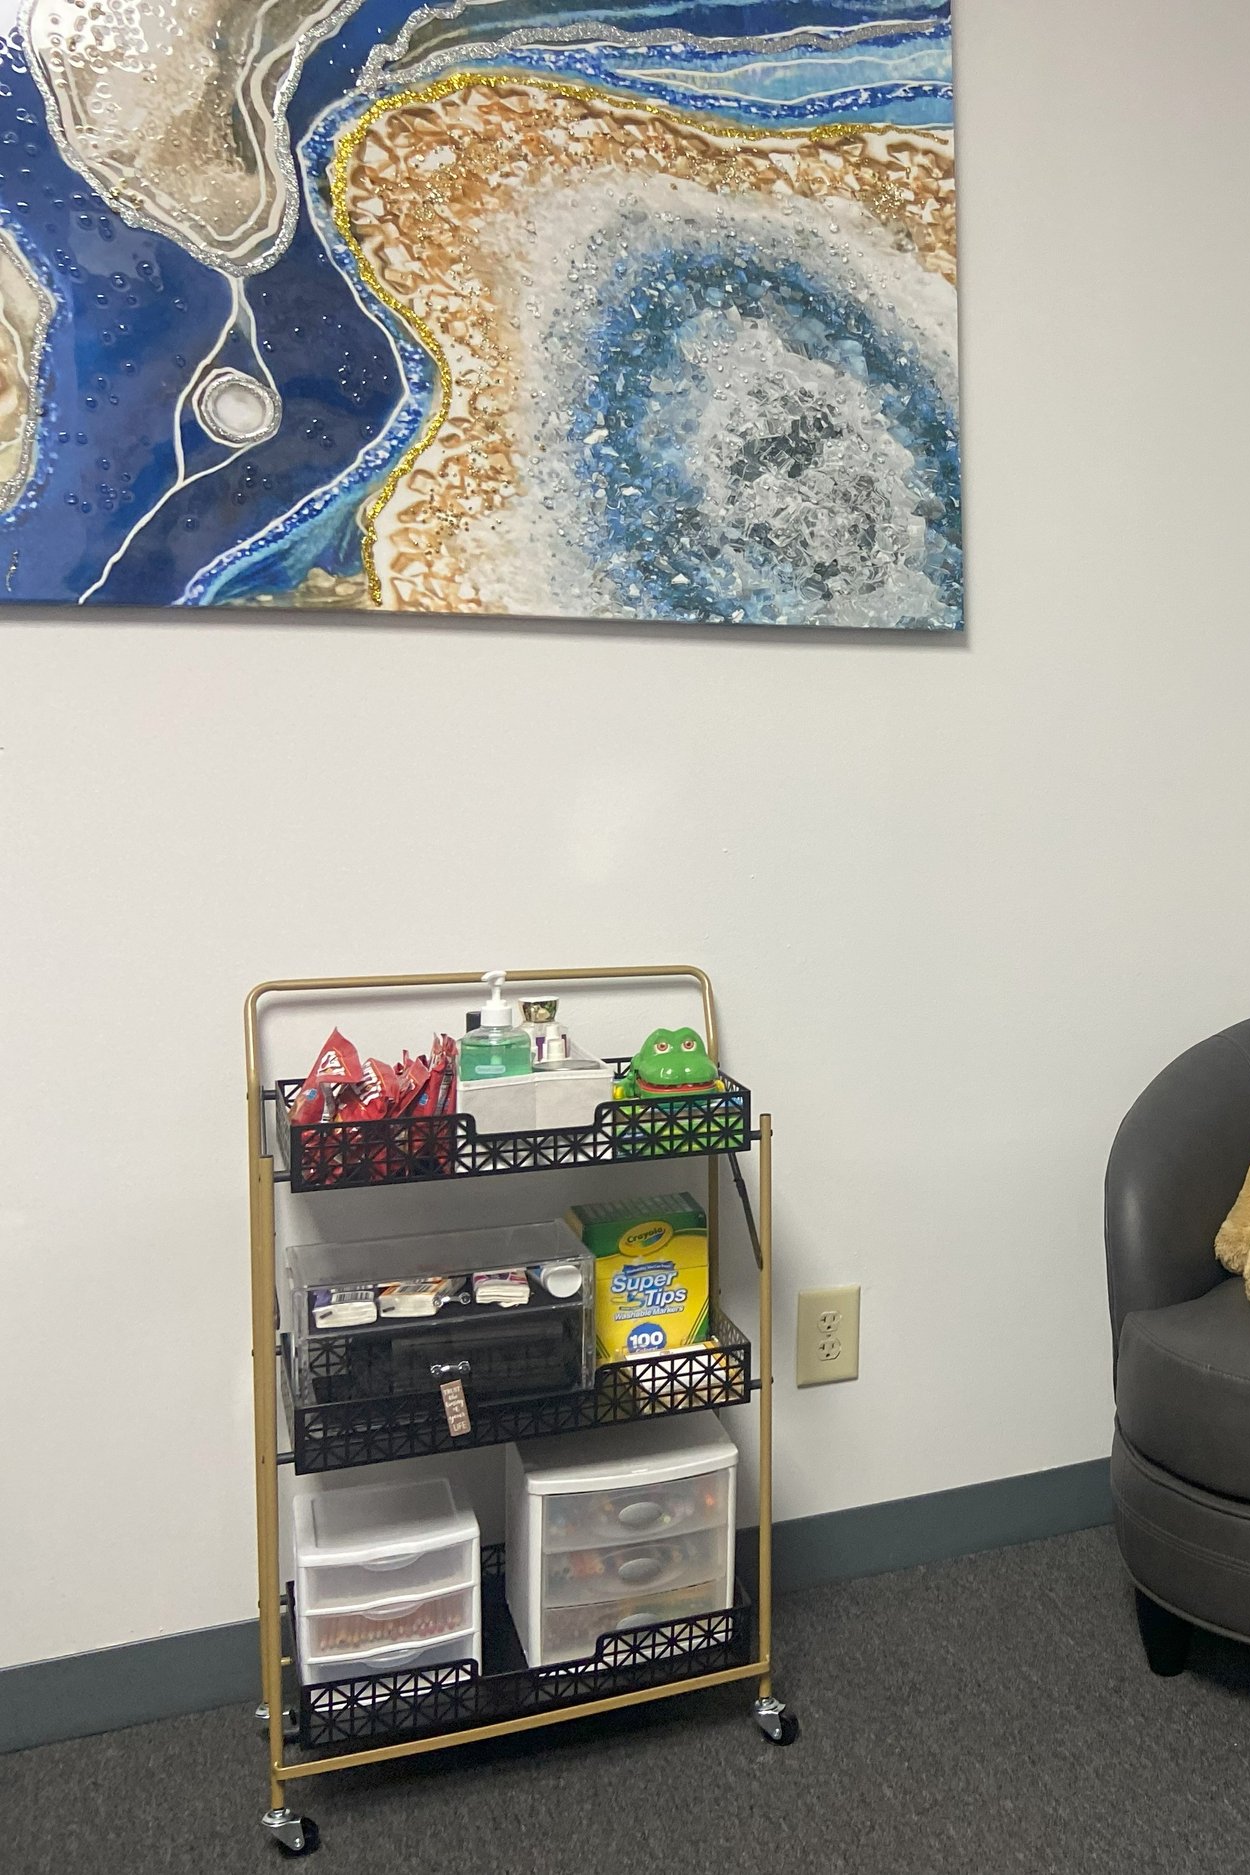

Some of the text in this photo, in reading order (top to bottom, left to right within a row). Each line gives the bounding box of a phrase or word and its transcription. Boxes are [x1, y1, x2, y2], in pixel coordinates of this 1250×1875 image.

[627, 1228, 664, 1243] Crayola
[611, 1270, 678, 1293] Super
[644, 1286, 688, 1308] Tips
[614, 1306, 684, 1321] Washable Markers
[629, 1330, 664, 1349] 100
[452, 1420, 467, 1431] LIFE
